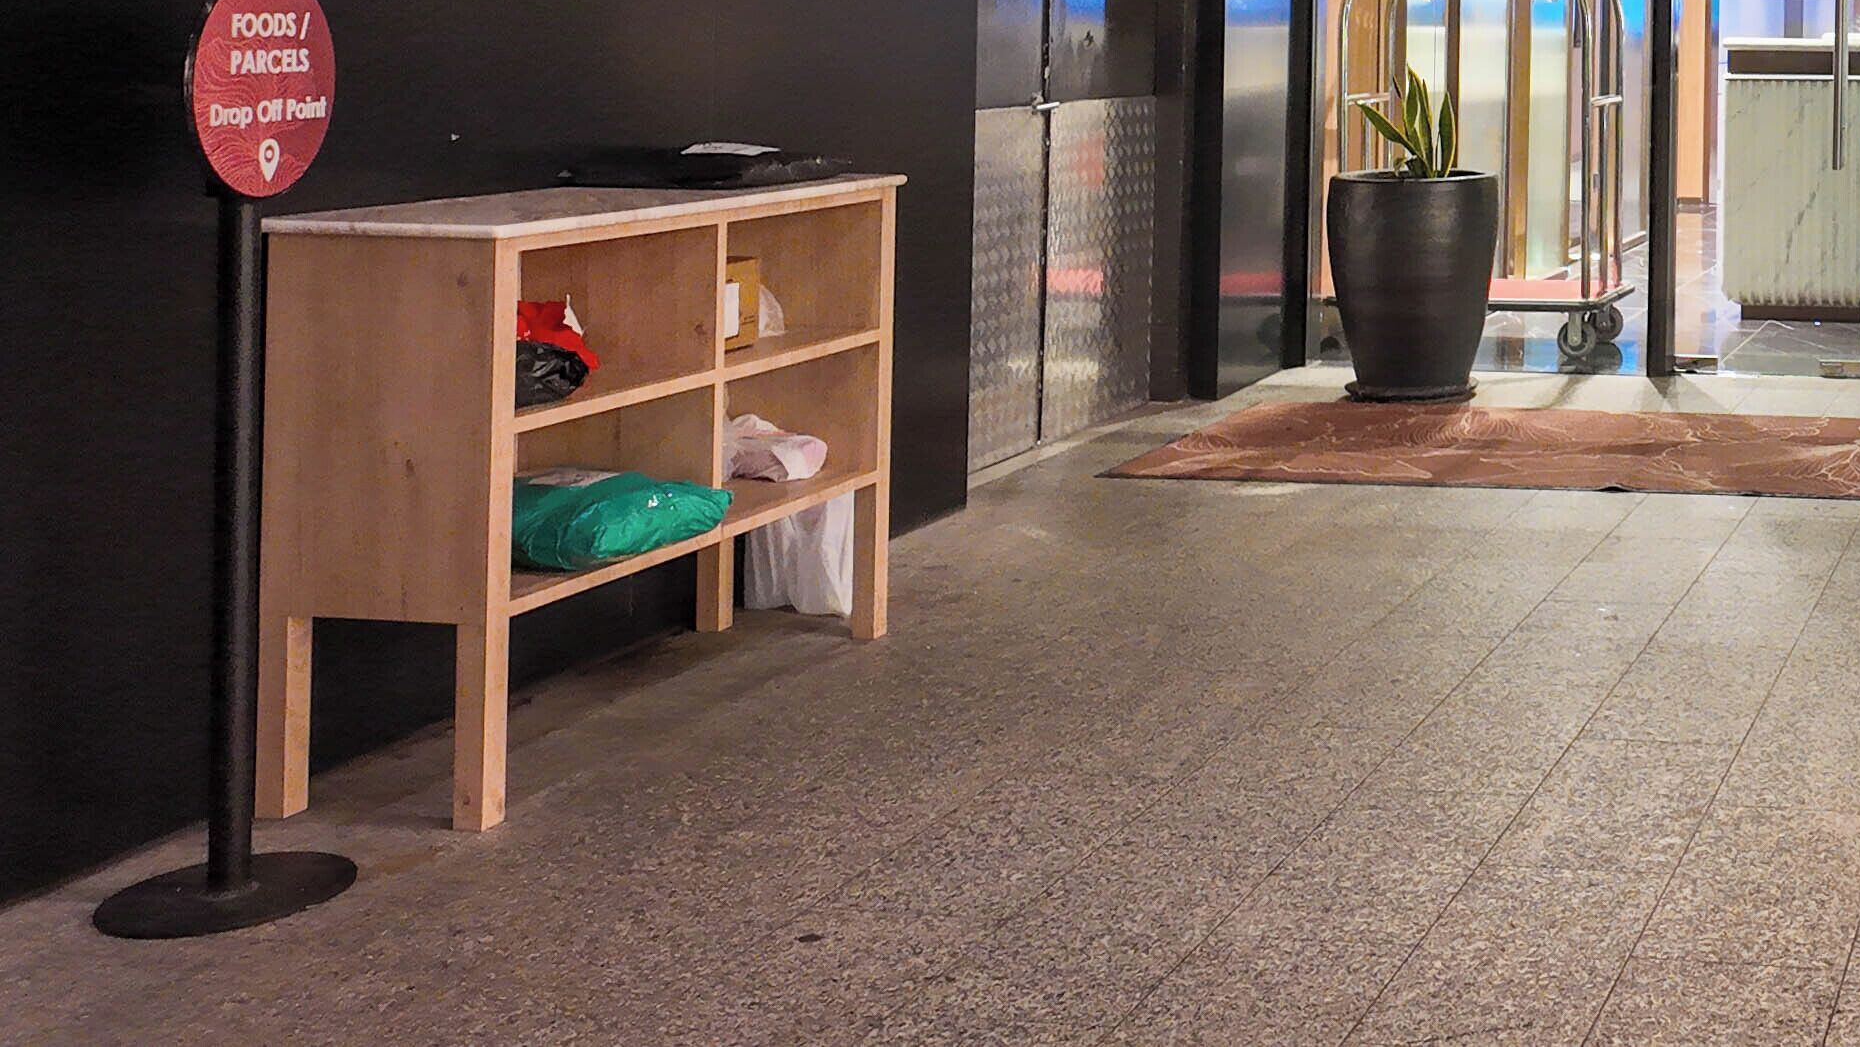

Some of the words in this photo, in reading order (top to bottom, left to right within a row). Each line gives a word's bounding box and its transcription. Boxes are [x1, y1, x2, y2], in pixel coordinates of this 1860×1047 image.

[231, 12, 297, 39] FOODS
[299, 11, 311, 41] /
[230, 48, 310, 75] PARCELS
[209, 103, 253, 129] Drop
[257, 97, 283, 123] Off
[286, 95, 327, 122] Point
